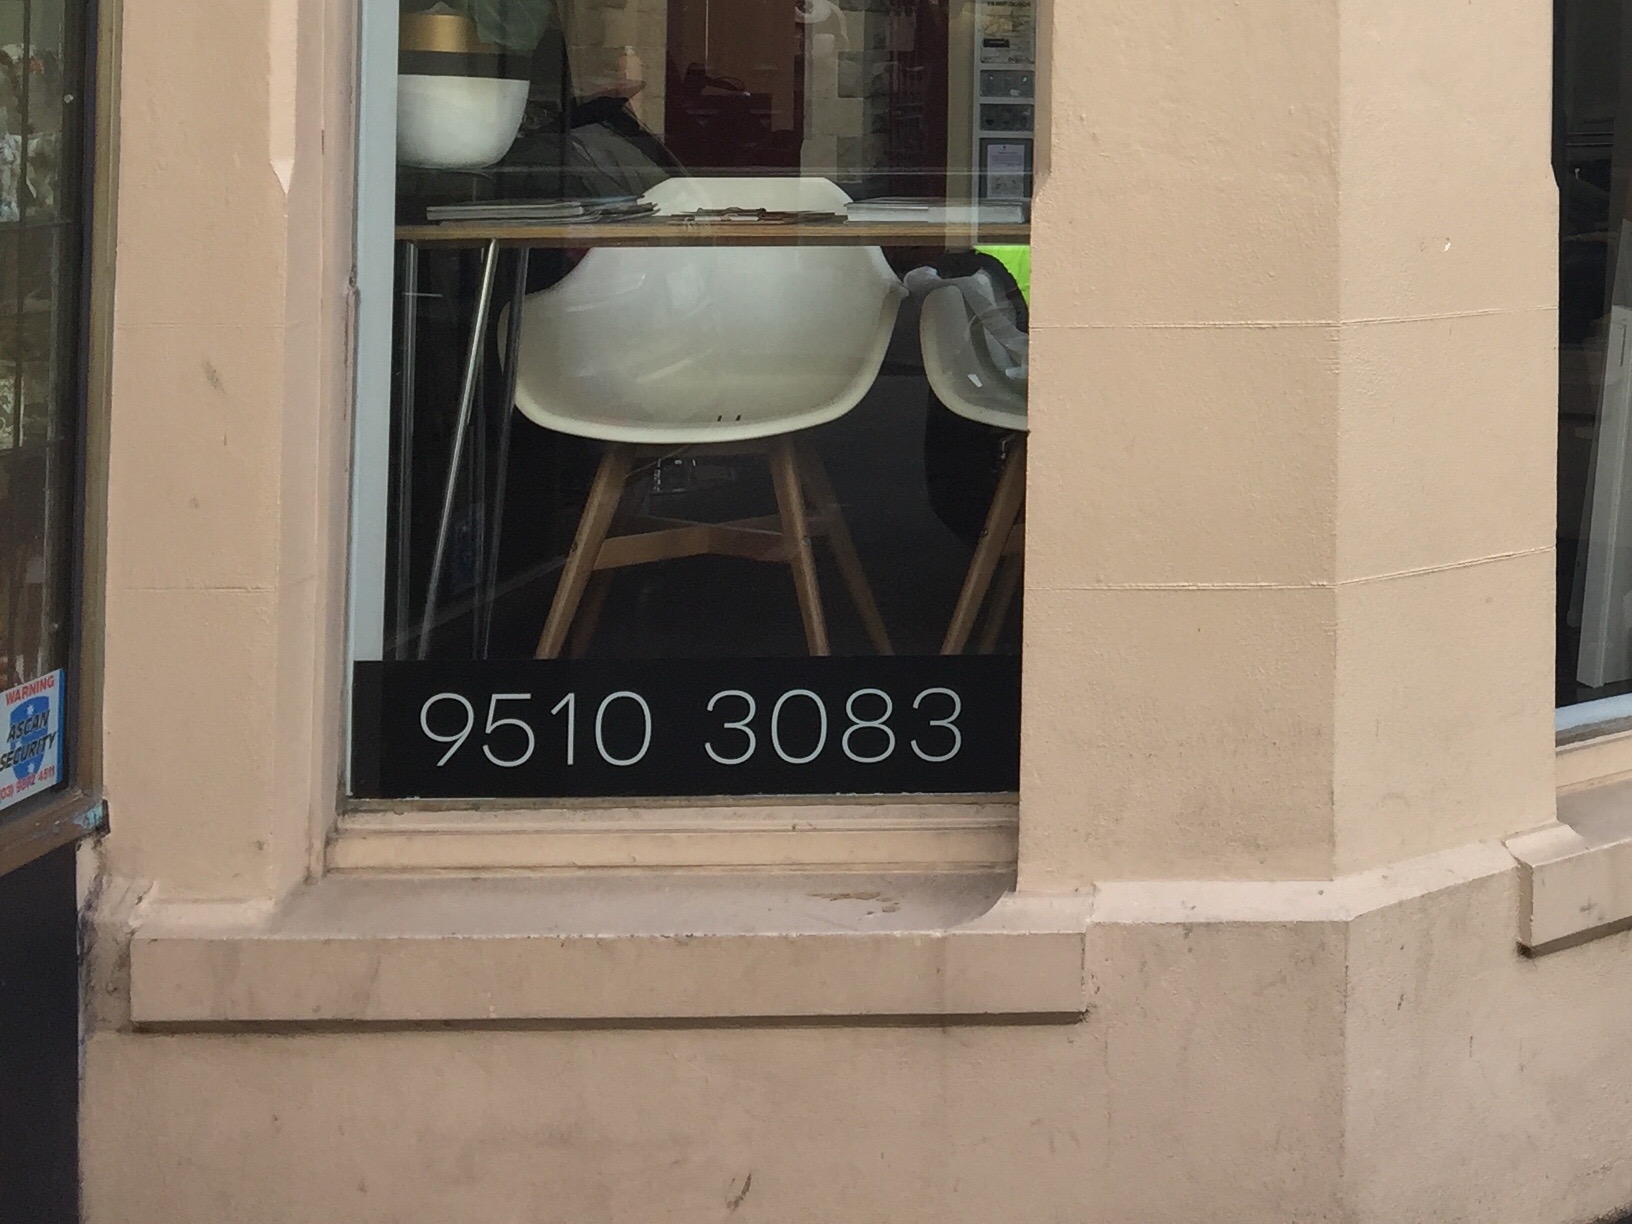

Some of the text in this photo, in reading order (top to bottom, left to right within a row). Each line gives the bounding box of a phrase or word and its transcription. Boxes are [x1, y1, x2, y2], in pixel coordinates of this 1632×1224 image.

[5, 674, 55, 706] WARNING
[6, 709, 51, 744] ASCAN
[419, 686, 963, 768] 9510 3083
[0, 730, 57, 772] SECURITY
